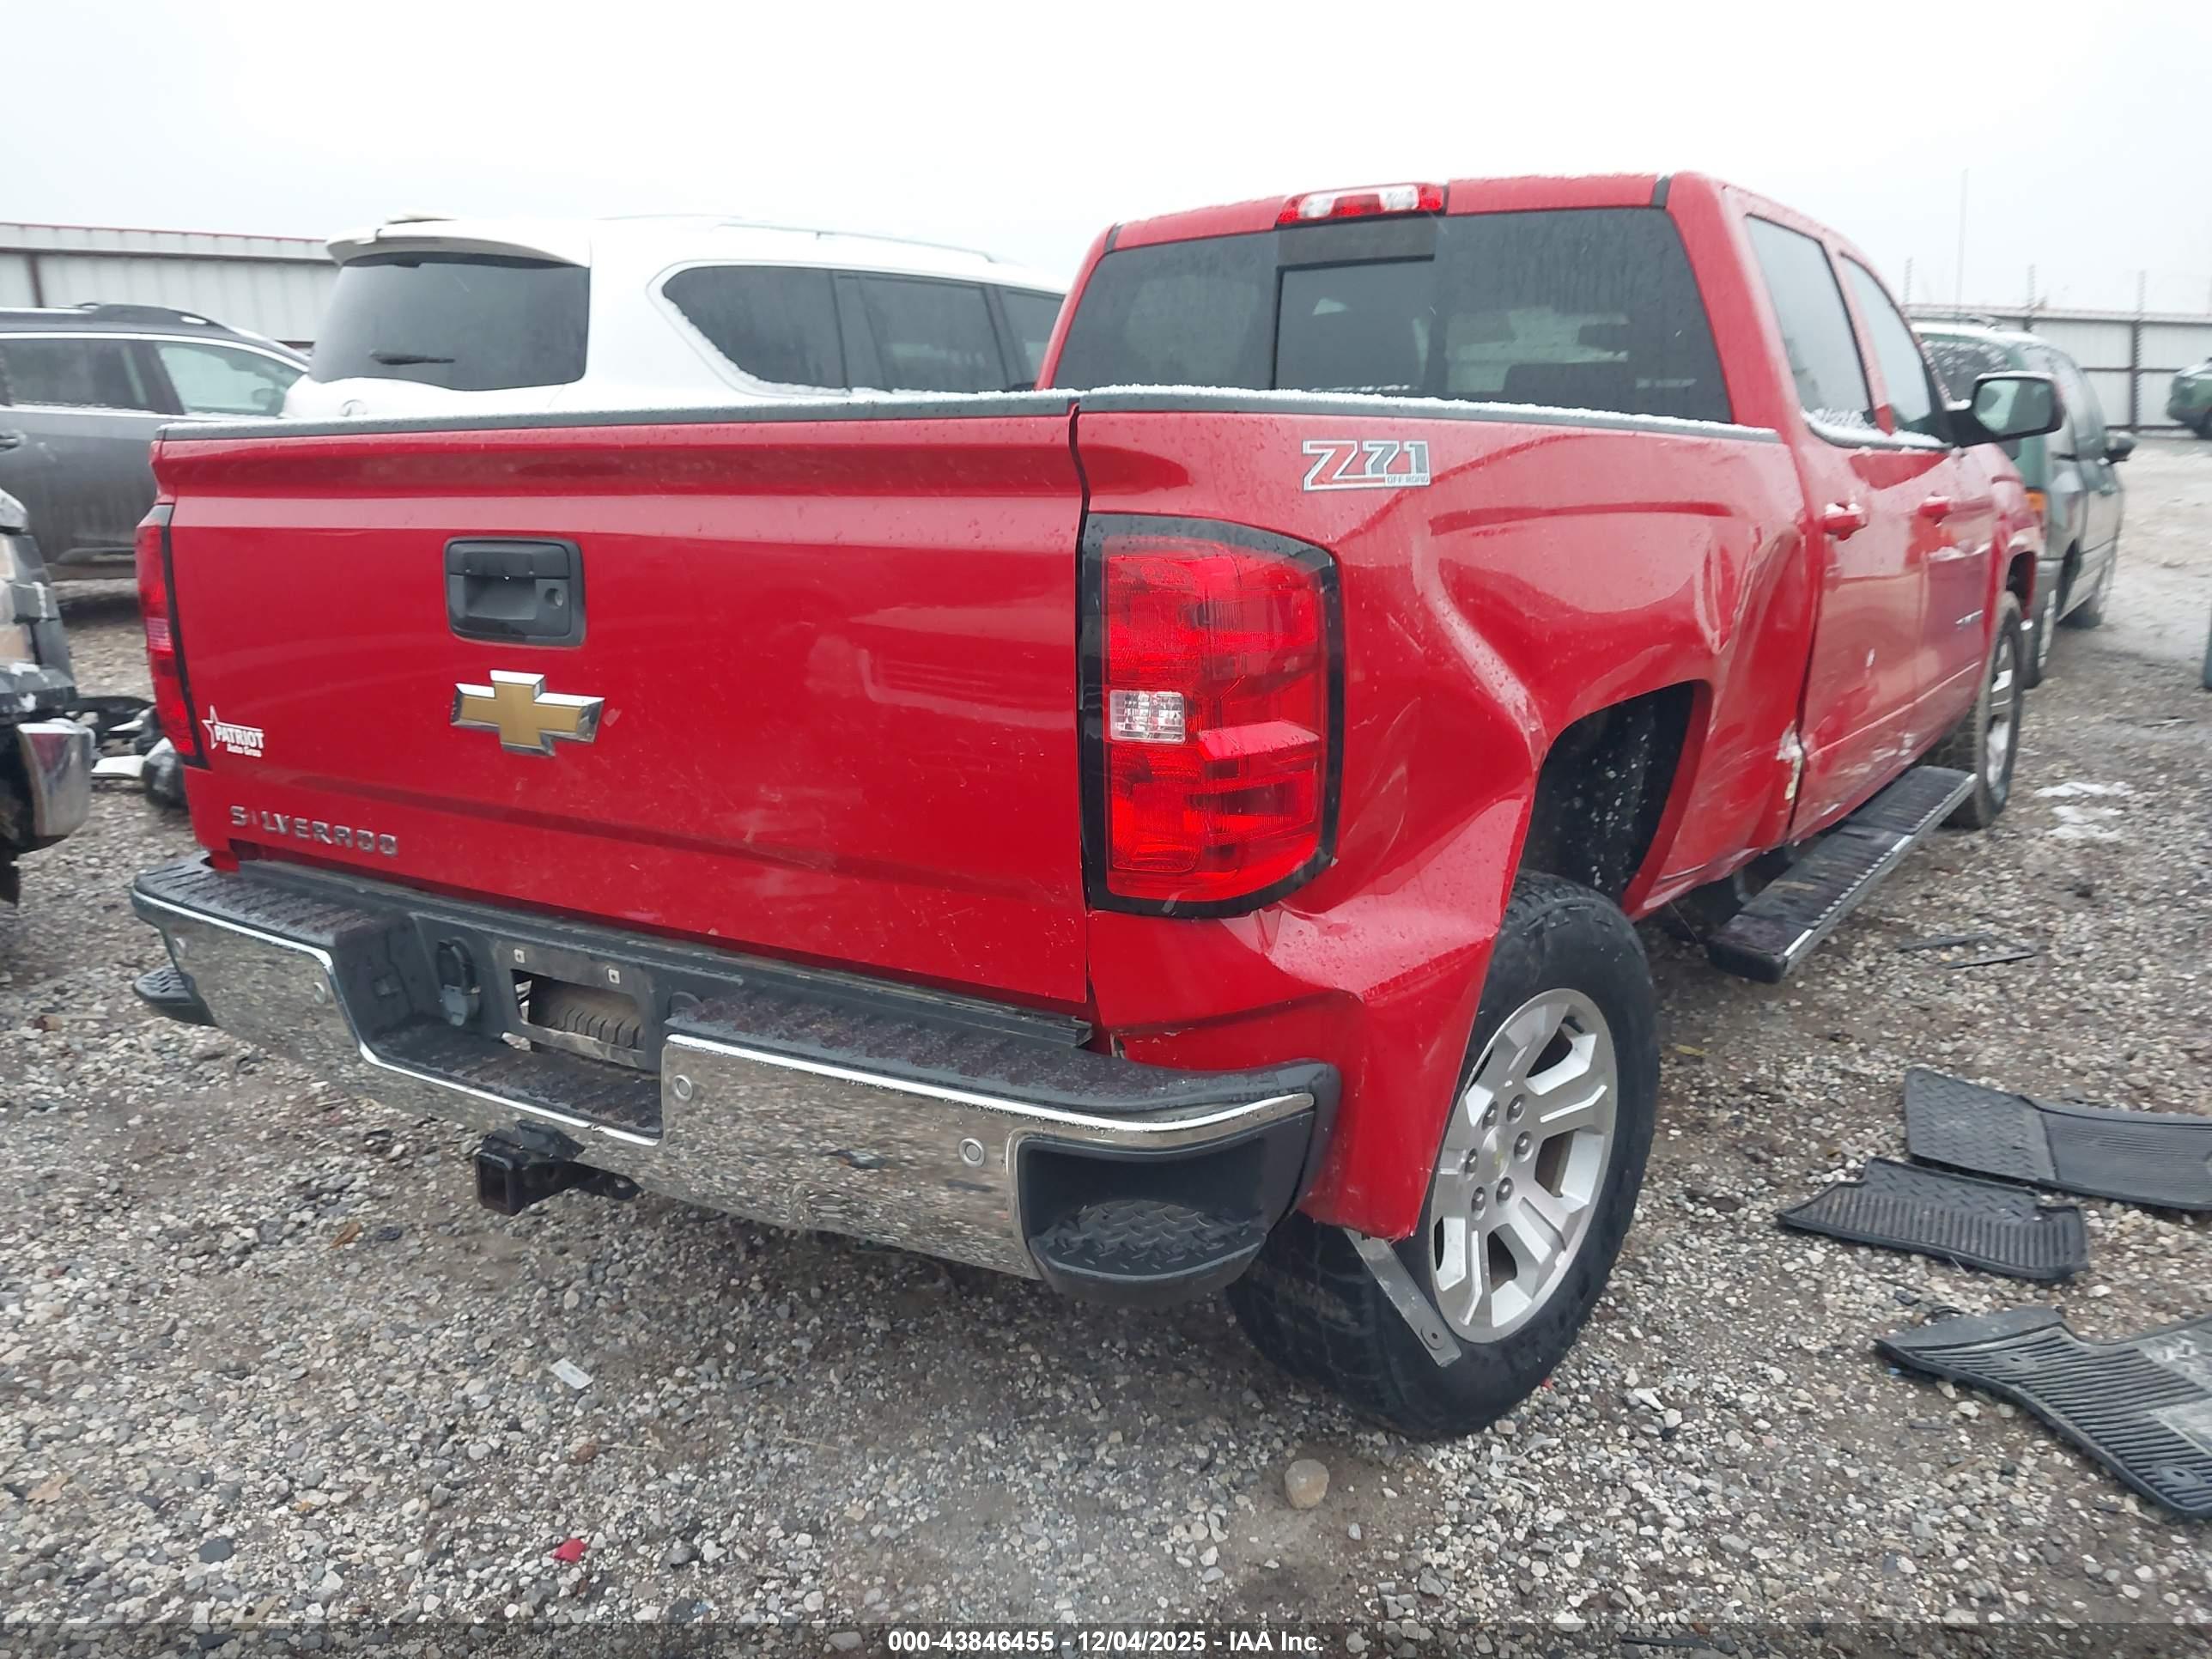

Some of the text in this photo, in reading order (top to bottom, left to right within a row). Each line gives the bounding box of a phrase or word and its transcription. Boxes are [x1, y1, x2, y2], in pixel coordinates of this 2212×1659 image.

[1302, 439, 1431, 492] Z71
[214, 725, 264, 749] PATRIOT
[229, 805, 398, 857] SILVERADO
